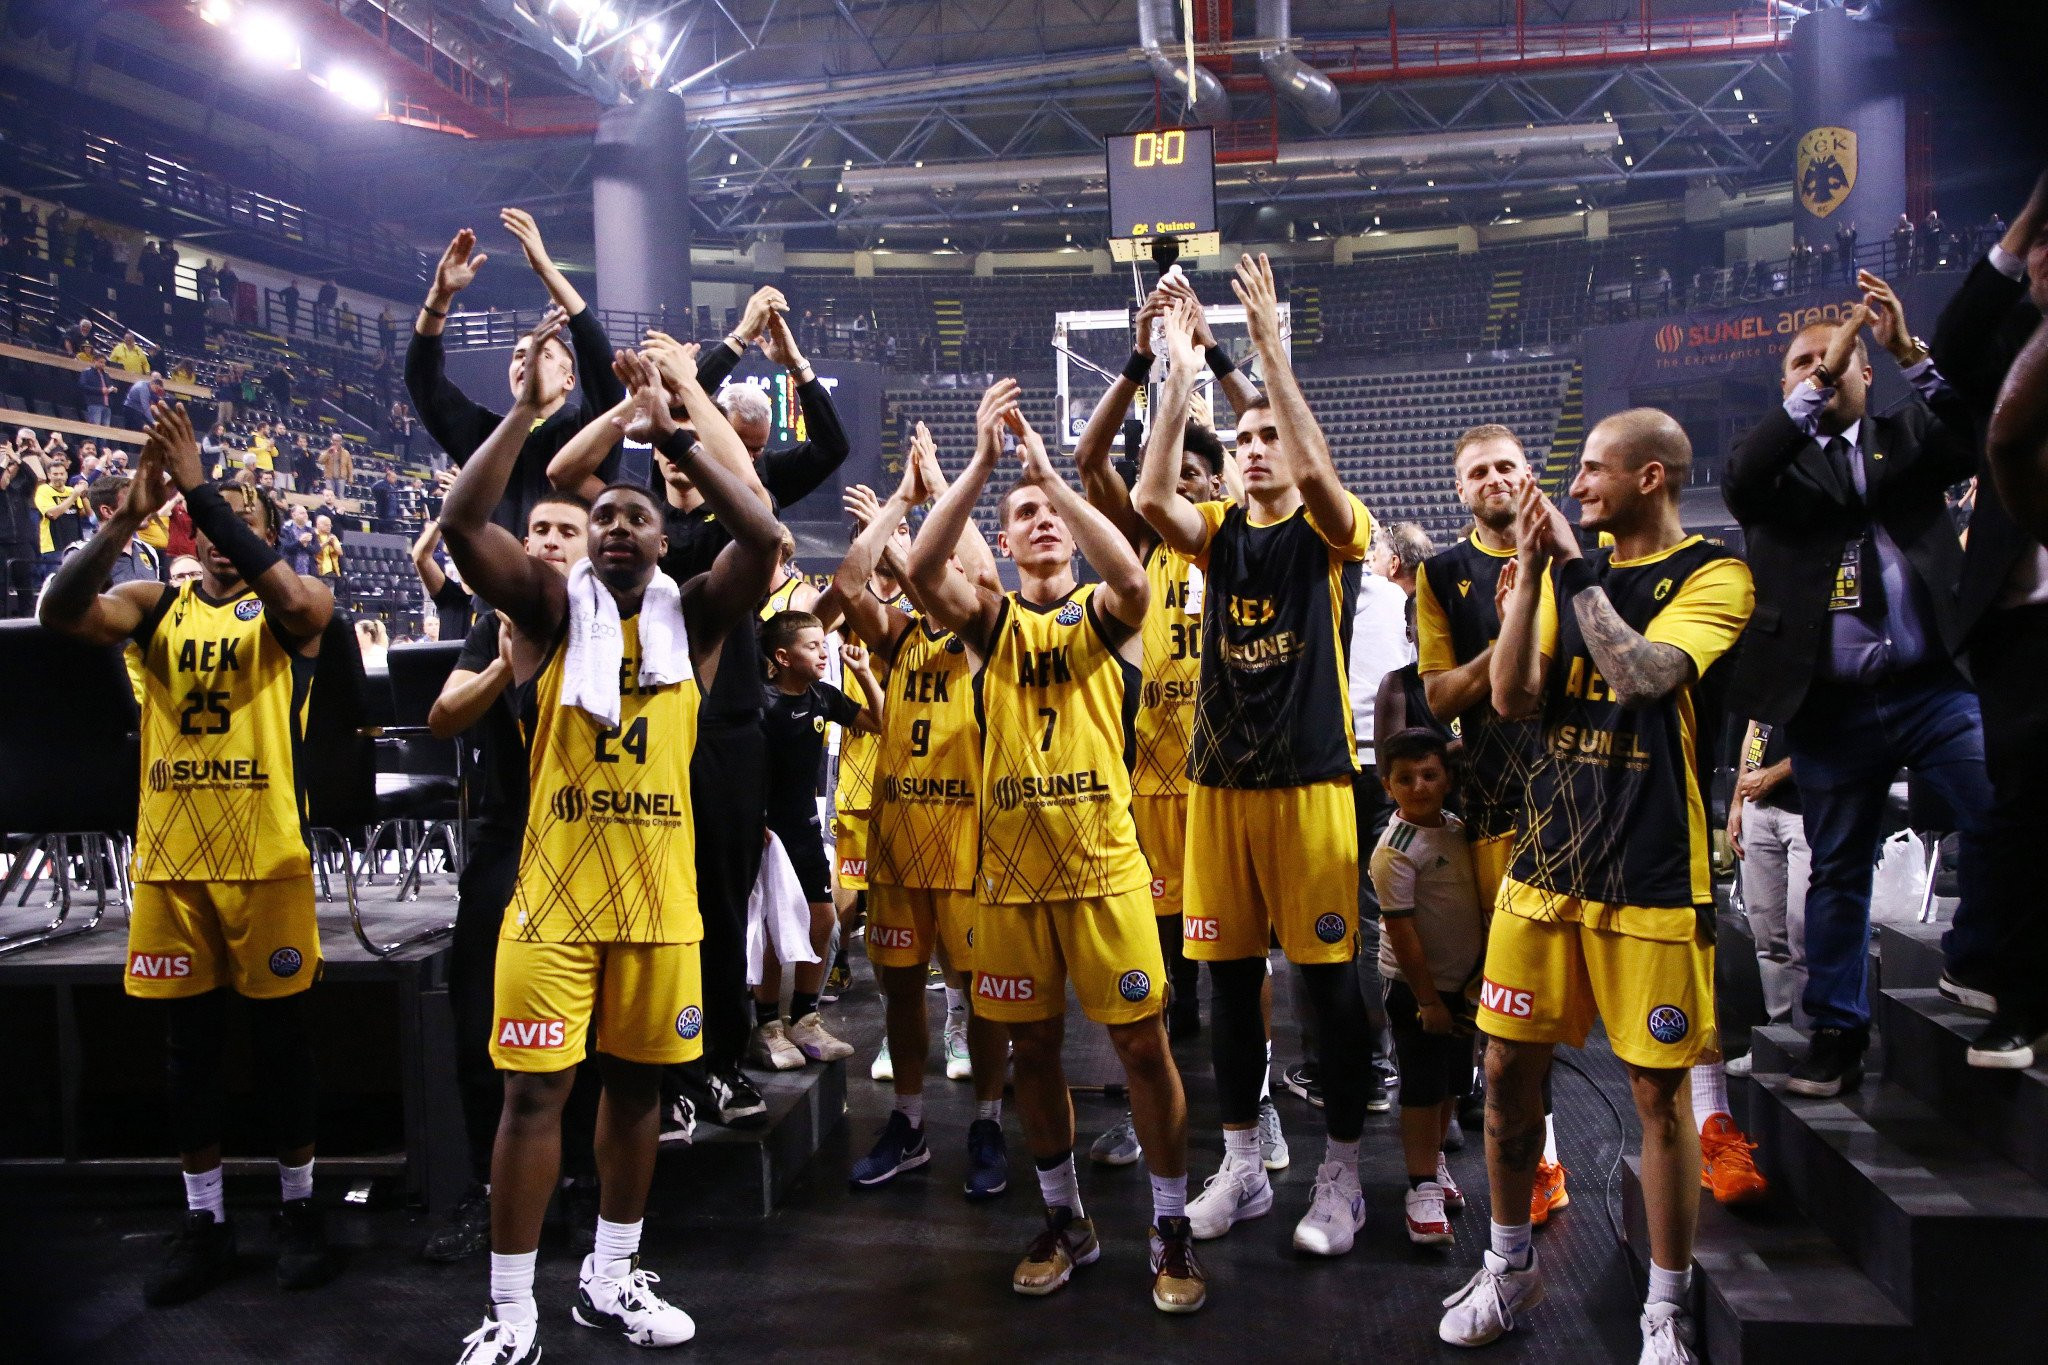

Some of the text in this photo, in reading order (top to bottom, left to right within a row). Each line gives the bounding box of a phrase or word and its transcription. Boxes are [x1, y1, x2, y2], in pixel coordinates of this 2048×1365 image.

[1133, 130, 1185, 168] 0:0
[1687, 302, 1855, 347] SUNEL arena
[1165, 580, 1190, 610] AE
[178, 637, 240, 673] AEK
[1020, 645, 1073, 689] AEK
[903, 669, 950, 704] AEK
[1564, 655, 1617, 702] AE
[180, 691, 231, 736] 25
[1038, 707, 1058, 752] 7
[594, 716, 649, 765] 24
[911, 719, 931, 758] 9
[172, 759, 269, 781] SUNEL
[1022, 769, 1110, 800] SUNEL
[591, 789, 682, 817] SUNEL
[902, 777, 975, 798] SUNEL
[652, 818, 682, 829] Change
[841, 859, 867, 875] AVI
[869, 926, 913, 949] AVIS
[131, 954, 190, 977] AVIS
[978, 975, 1033, 1000] AVIS
[1480, 979, 1533, 1016] AVIS
[499, 1020, 565, 1046] AVIS
